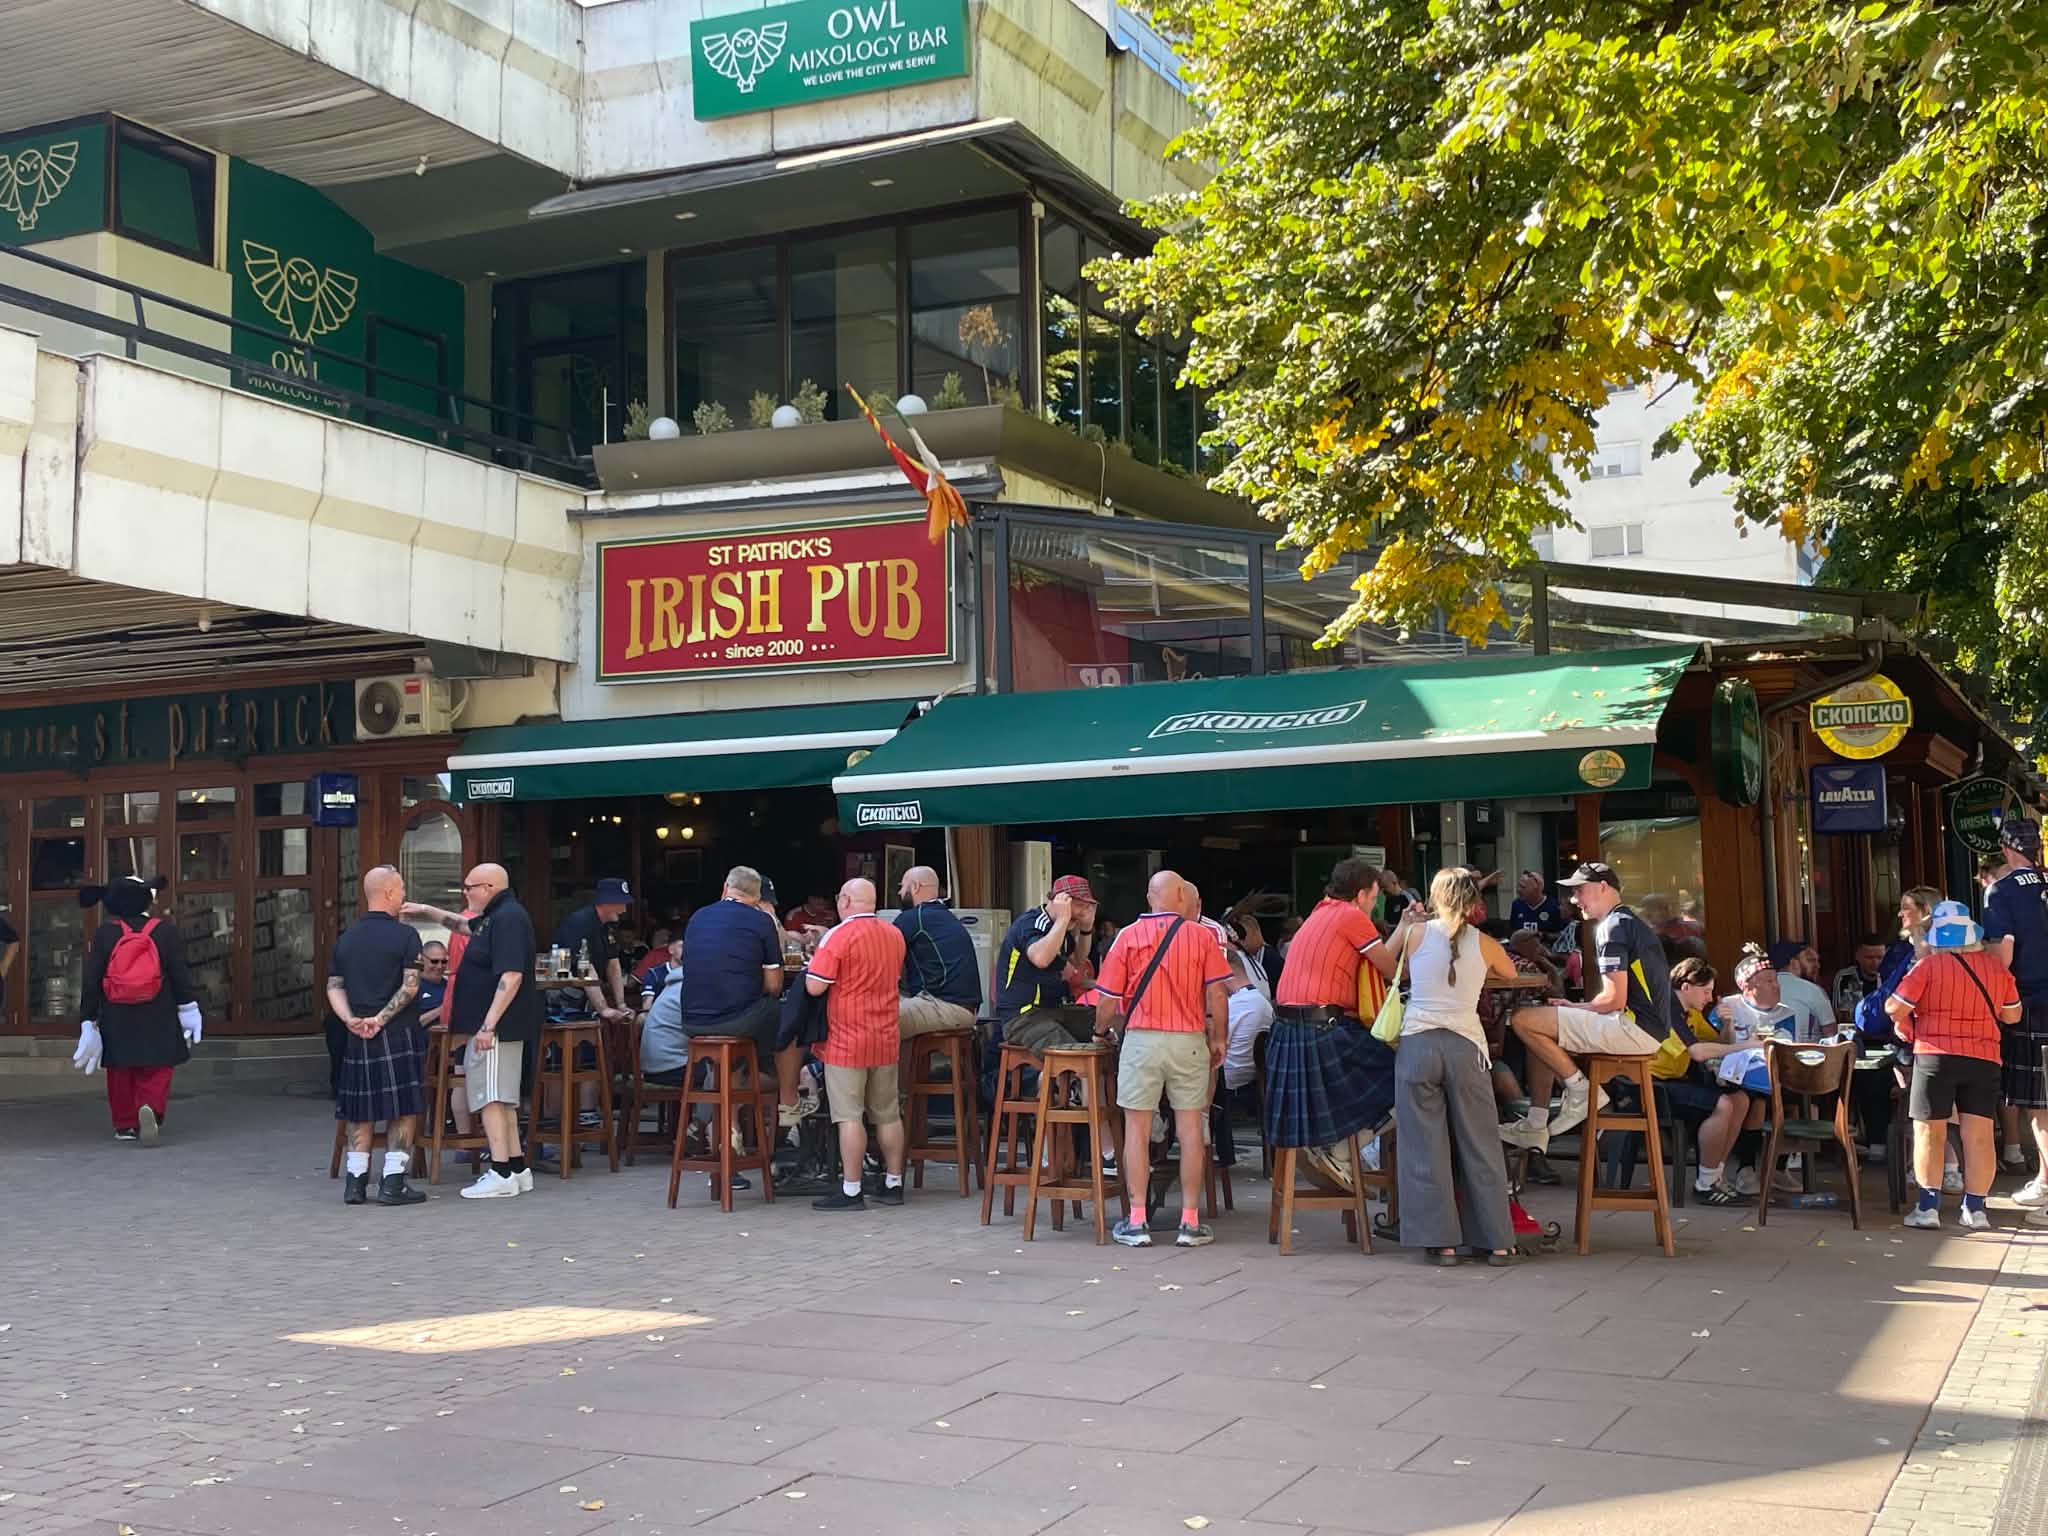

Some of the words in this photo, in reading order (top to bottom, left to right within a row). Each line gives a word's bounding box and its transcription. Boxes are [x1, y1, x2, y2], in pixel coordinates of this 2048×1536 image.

[827, 0, 906, 39] OWL
[789, 34, 902, 72] MIXOLOGY
[908, 26, 948, 51] BAR
[803, 76, 818, 87] WE
[819, 72, 843, 85] LOVE
[845, 68, 864, 79] THE
[866, 64, 888, 76] CITY
[888, 60, 904, 72] WE
[905, 54, 936, 70] SERVE
[708, 545, 733, 566] ST
[738, 537, 832, 563] PATRICK'S
[625, 569, 784, 660] IRISH
[806, 558, 921, 641] PUB
[725, 642, 764, 659] since
[767, 639, 804, 656] 2000
[1816, 704, 1904, 726] СКОПСКО
